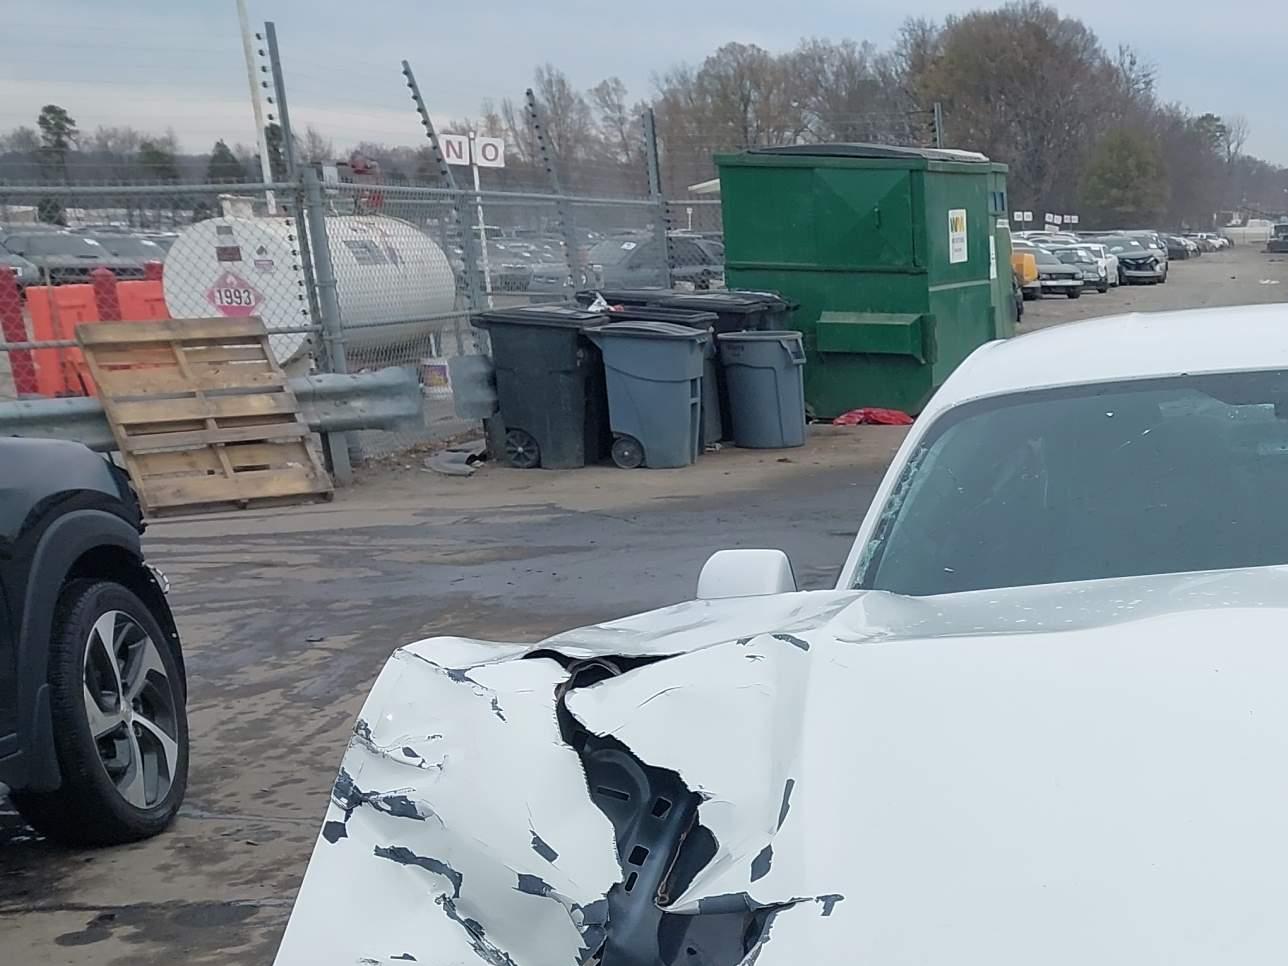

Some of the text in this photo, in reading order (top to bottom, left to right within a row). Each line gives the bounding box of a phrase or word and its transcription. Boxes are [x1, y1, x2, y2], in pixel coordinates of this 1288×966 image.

[443, 140, 499, 162] N O
[216, 288, 253, 306] 1993
